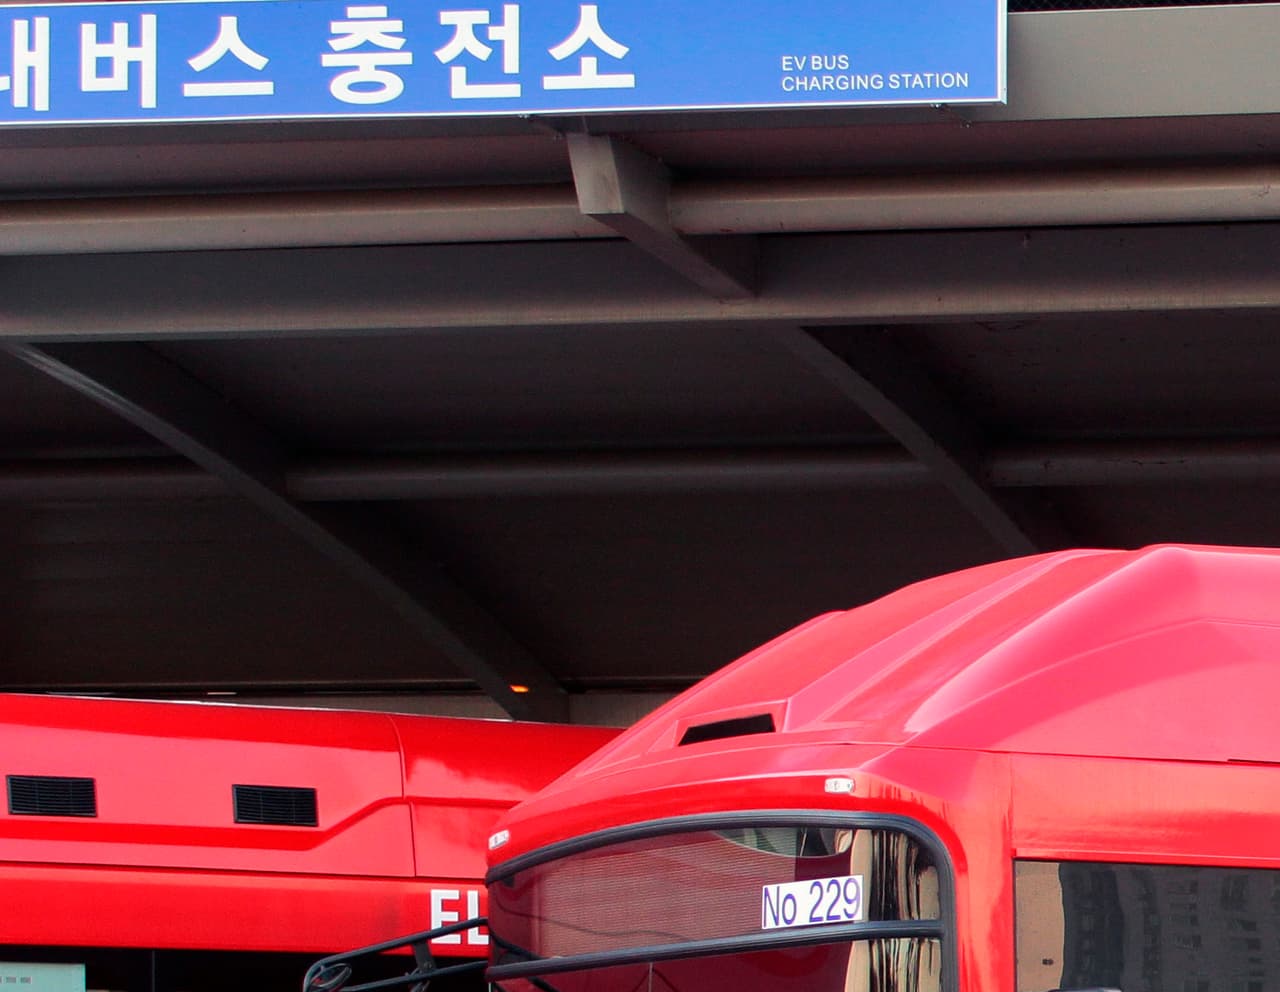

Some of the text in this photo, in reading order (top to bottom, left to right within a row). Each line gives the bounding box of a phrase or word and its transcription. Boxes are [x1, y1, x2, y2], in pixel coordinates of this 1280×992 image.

[321, 5, 635, 106] 충전소
[782, 54, 849, 71] EV BUS
[782, 72, 968, 91] CHARGING STATION
[763, 877, 861, 928] No 229
